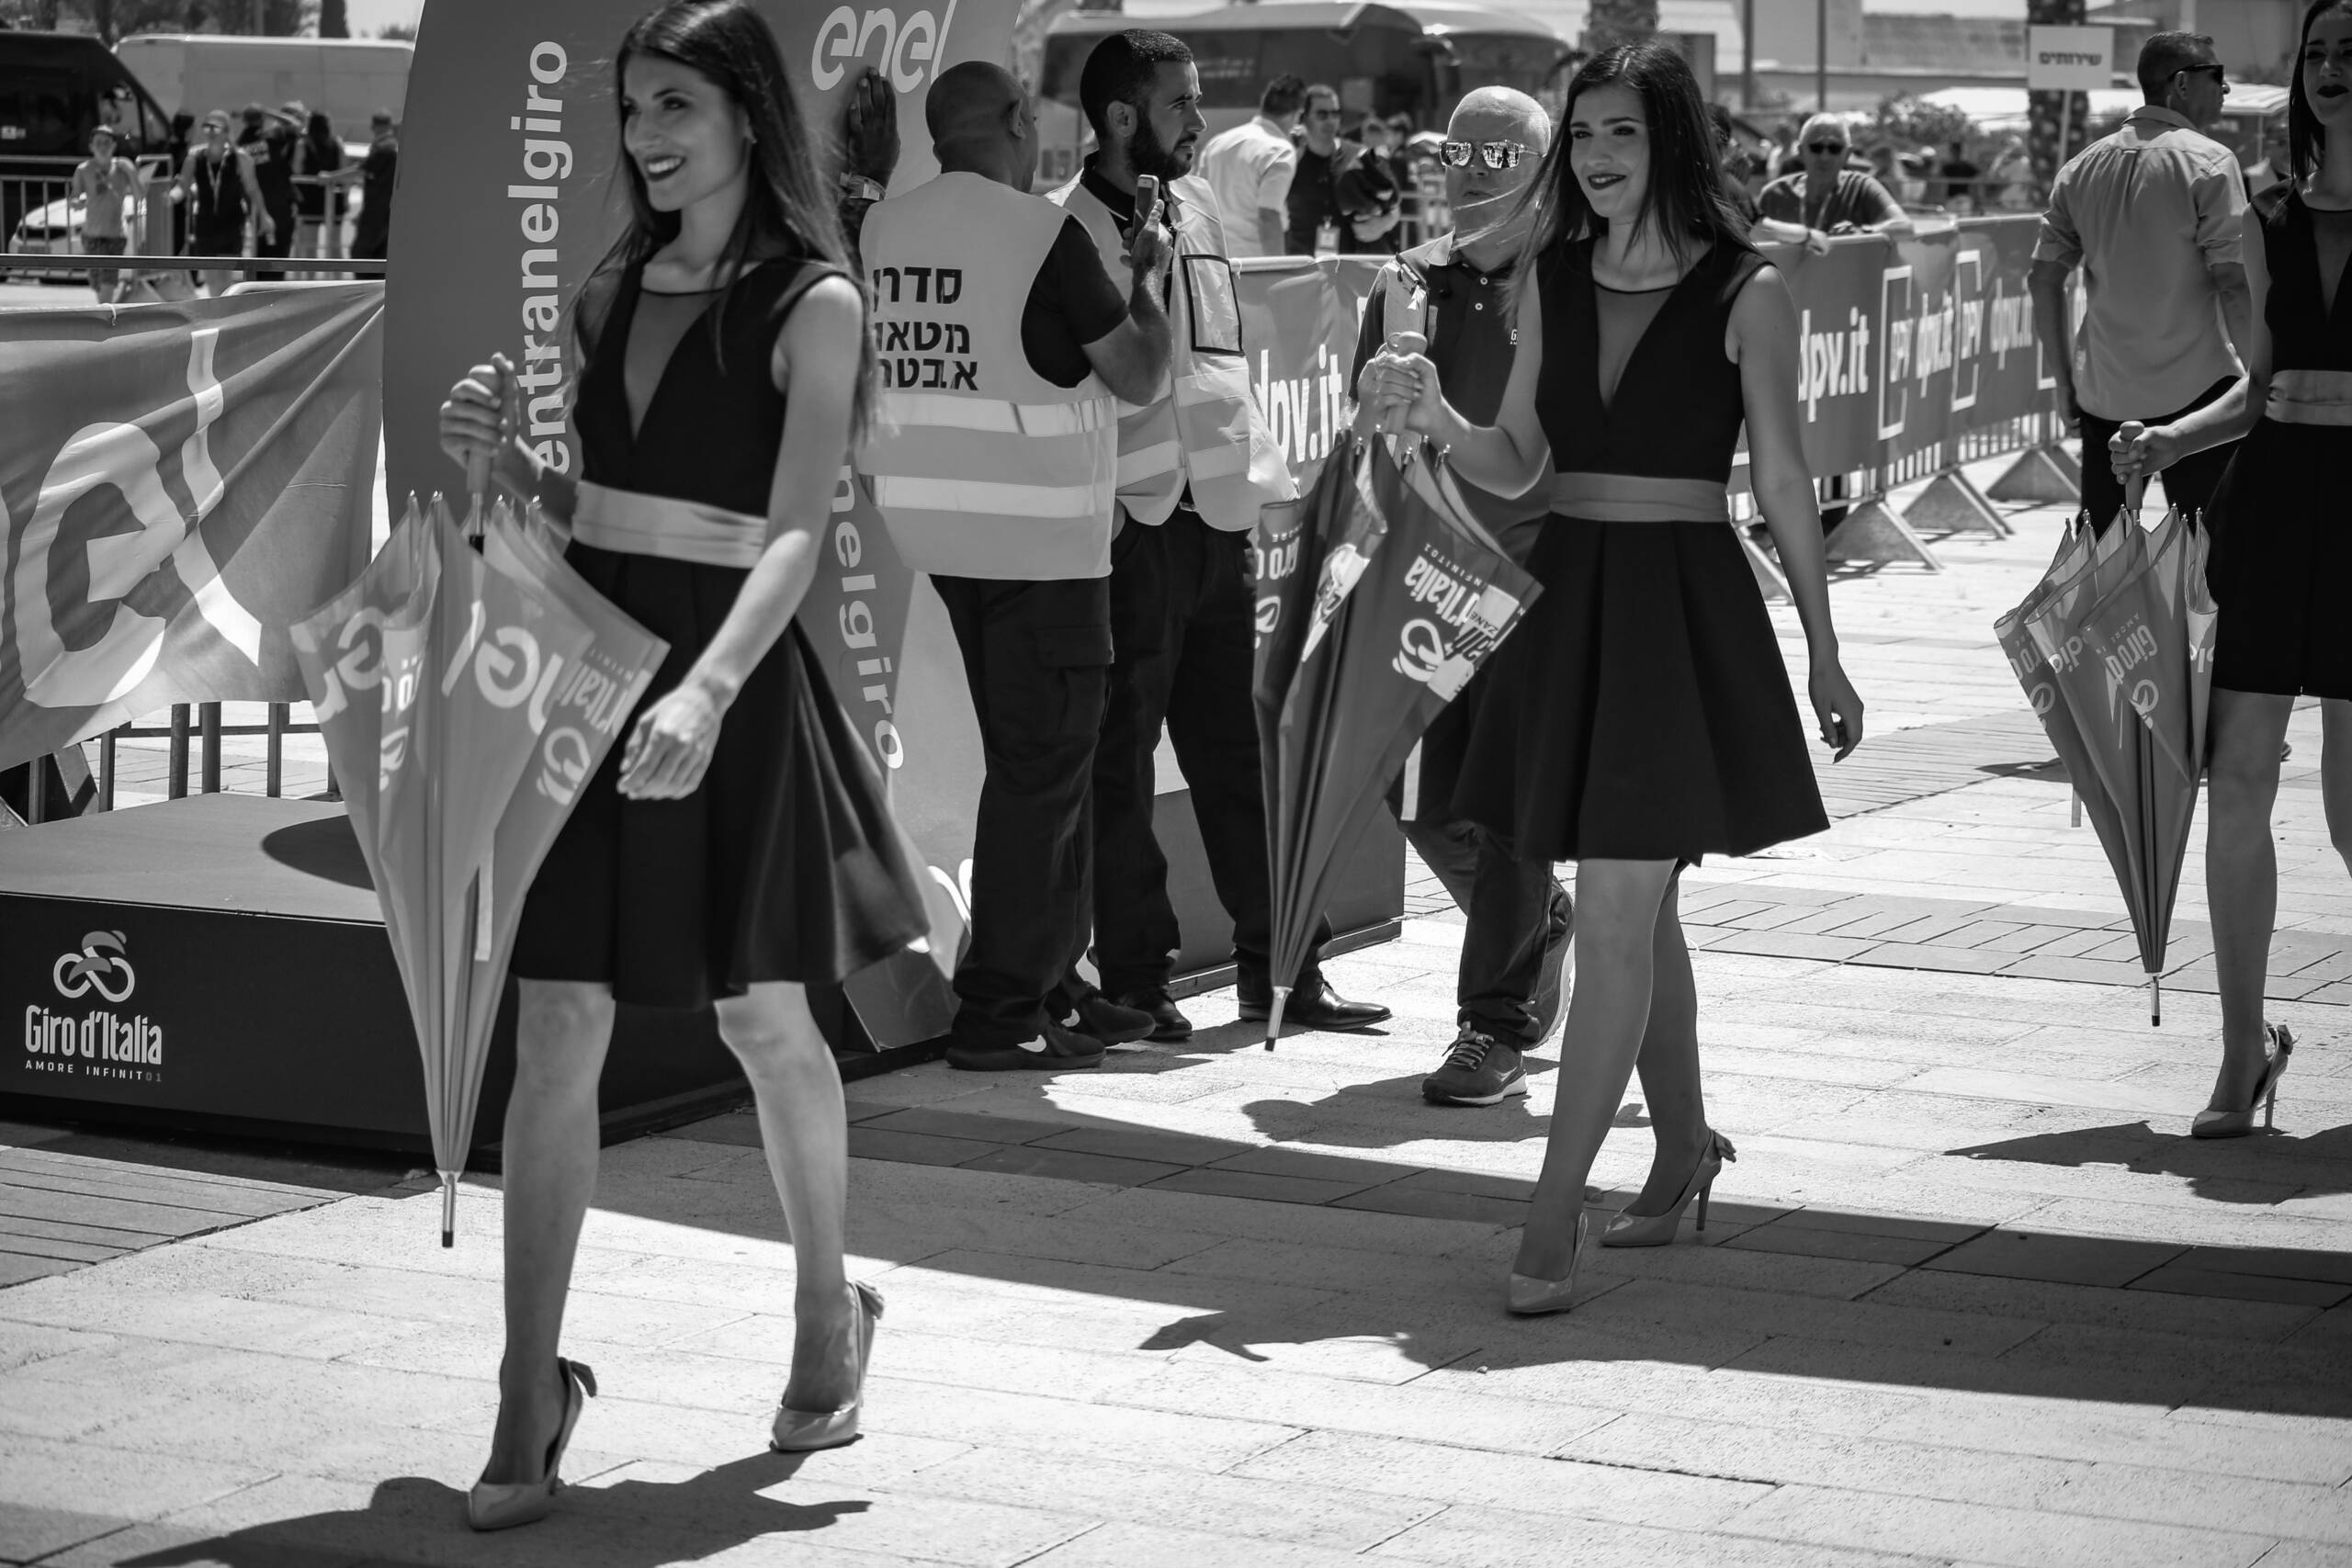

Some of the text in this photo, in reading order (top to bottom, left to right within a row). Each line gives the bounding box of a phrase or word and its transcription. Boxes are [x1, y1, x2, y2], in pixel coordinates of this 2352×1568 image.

[811, 0, 956, 93] enel
[2038, 51, 2103, 67] שירותים
[25, 1004, 162, 1065] Giro d'Italia
[26, 1060, 74, 1074] AMORE
